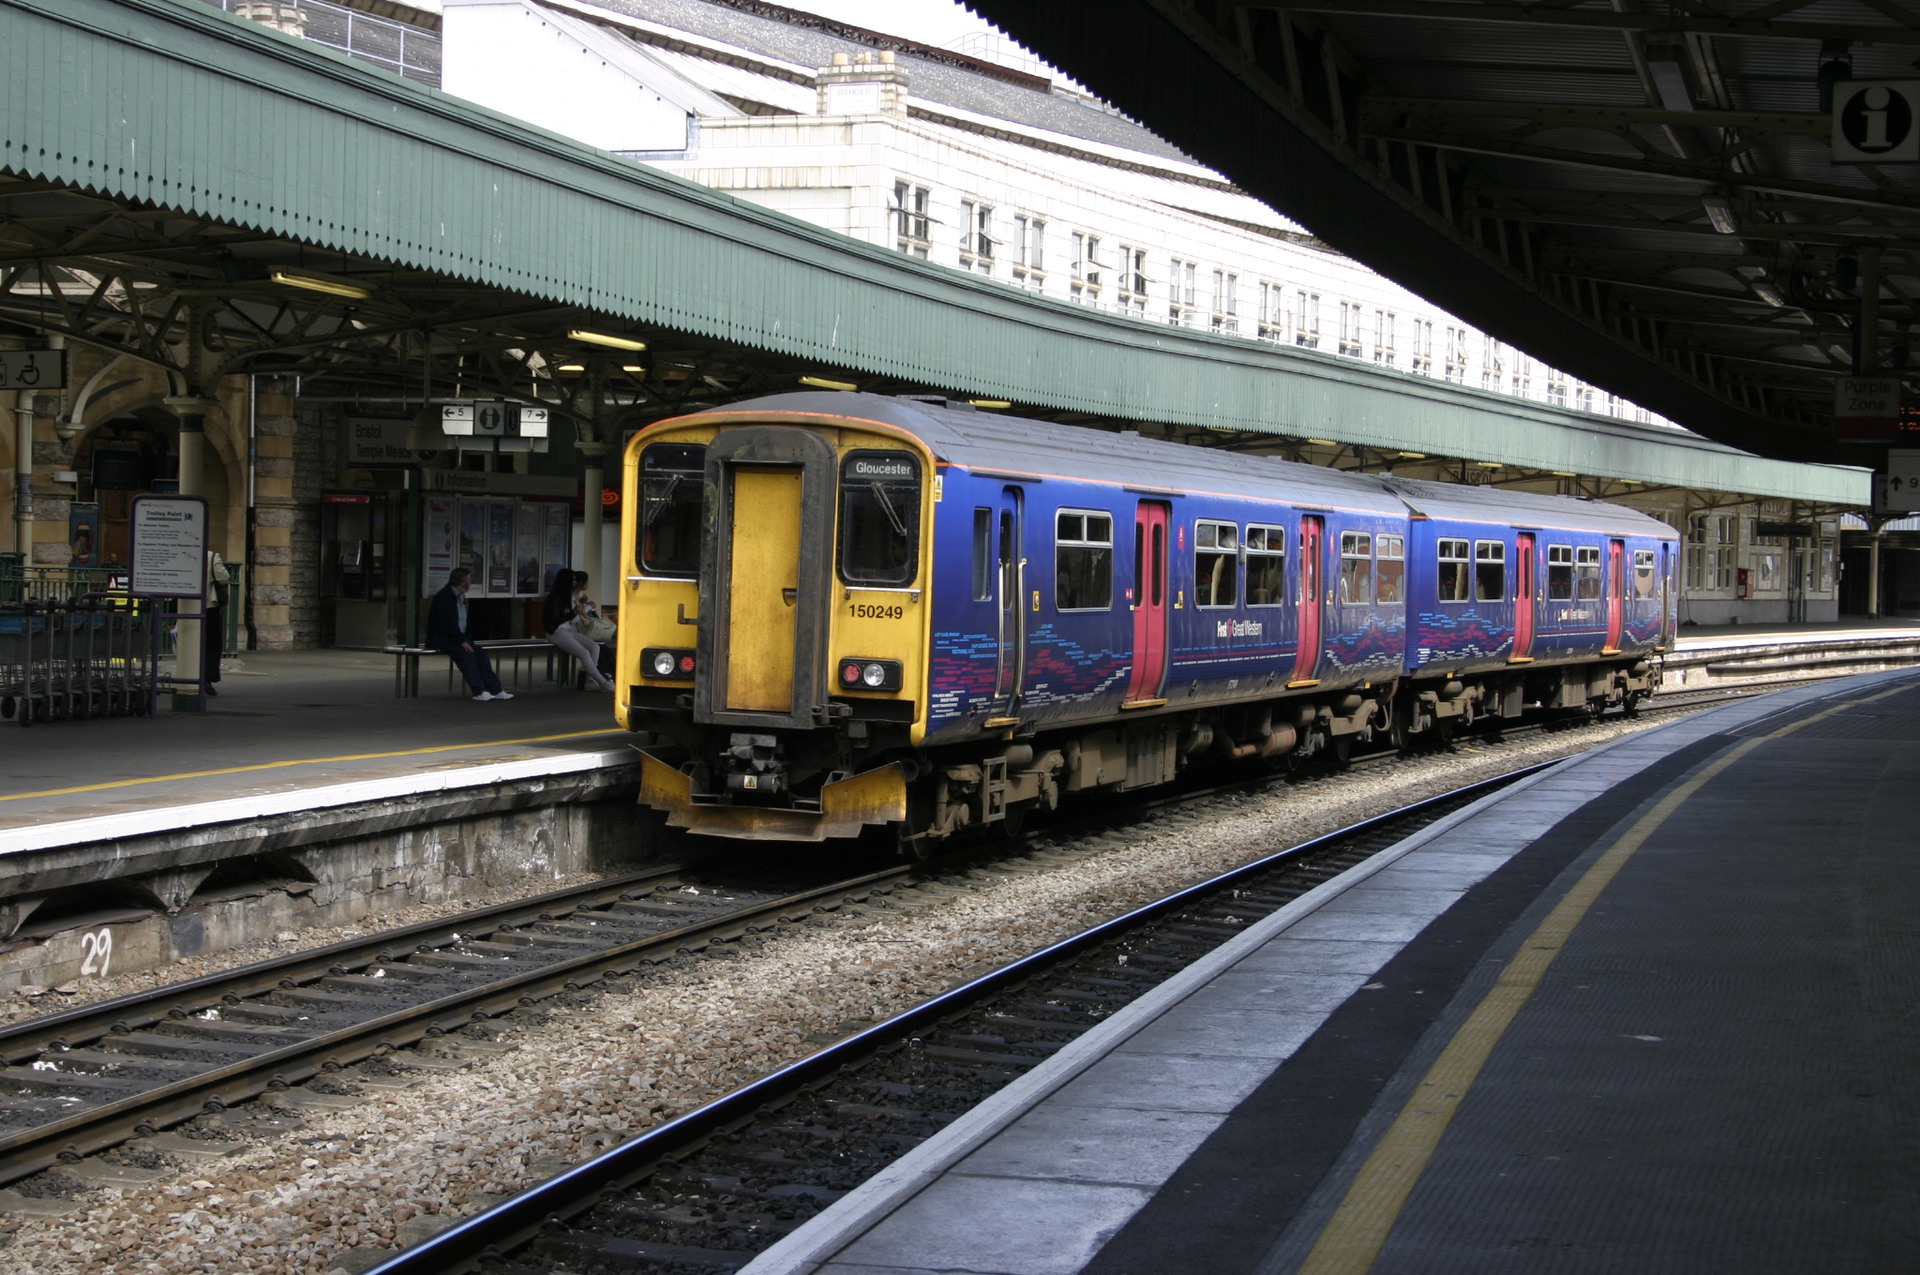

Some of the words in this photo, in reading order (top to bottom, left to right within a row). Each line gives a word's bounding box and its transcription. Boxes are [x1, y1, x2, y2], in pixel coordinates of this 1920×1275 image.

[1844, 381, 1891, 395] Purple
[1848, 398, 1886, 411] Zone
[458, 408, 464, 417] 5
[527, 410, 533, 418] 7
[355, 424, 382, 438] Bristol
[356, 443, 384, 459] Temple
[855, 462, 912, 475] Gloucester
[447, 473, 487, 488] Information
[1910, 477, 1918, 488] 9
[849, 604, 903, 620] 150249
[1217, 620, 1227, 637] First
[1232, 619, 1244, 637] Great
[1244, 619, 1262, 635] Western
[80, 927, 112, 978] 29
